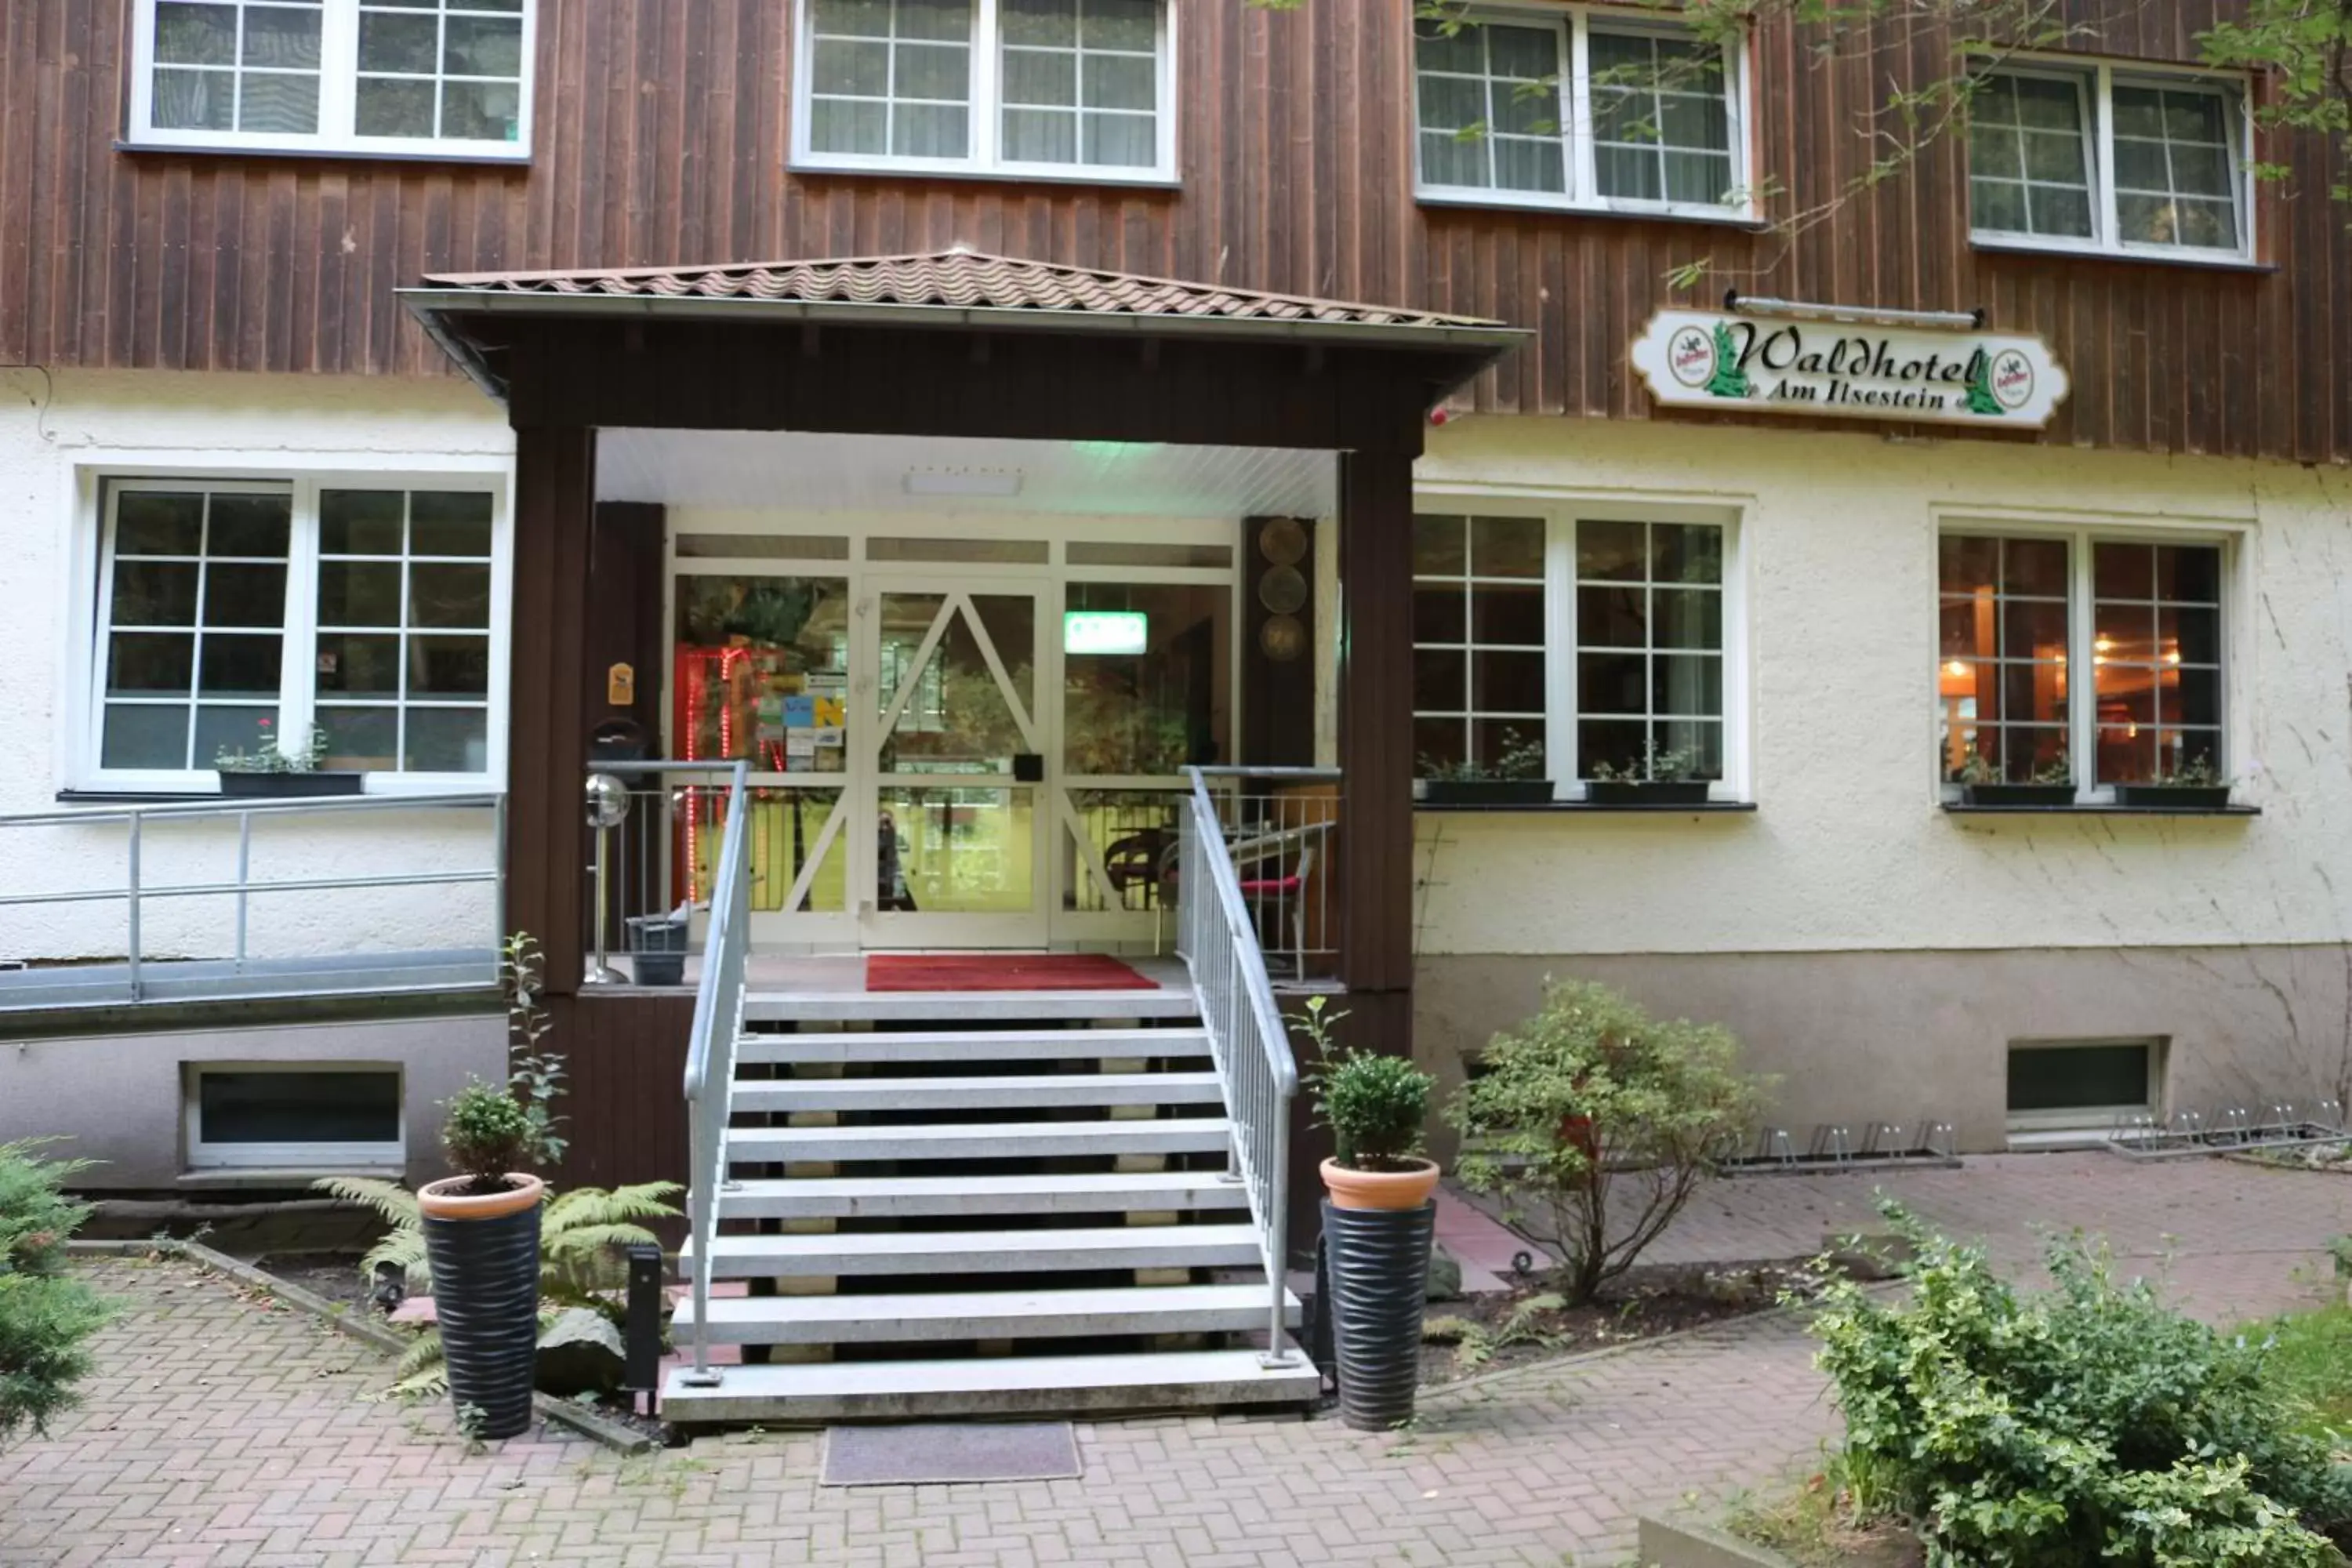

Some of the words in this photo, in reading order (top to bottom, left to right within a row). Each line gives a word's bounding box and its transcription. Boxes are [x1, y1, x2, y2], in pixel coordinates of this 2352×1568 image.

[1727, 321, 1984, 383] Waldhotel
[1766, 378, 1817, 401] Am
[1827, 379, 1944, 409] Ilsestein
